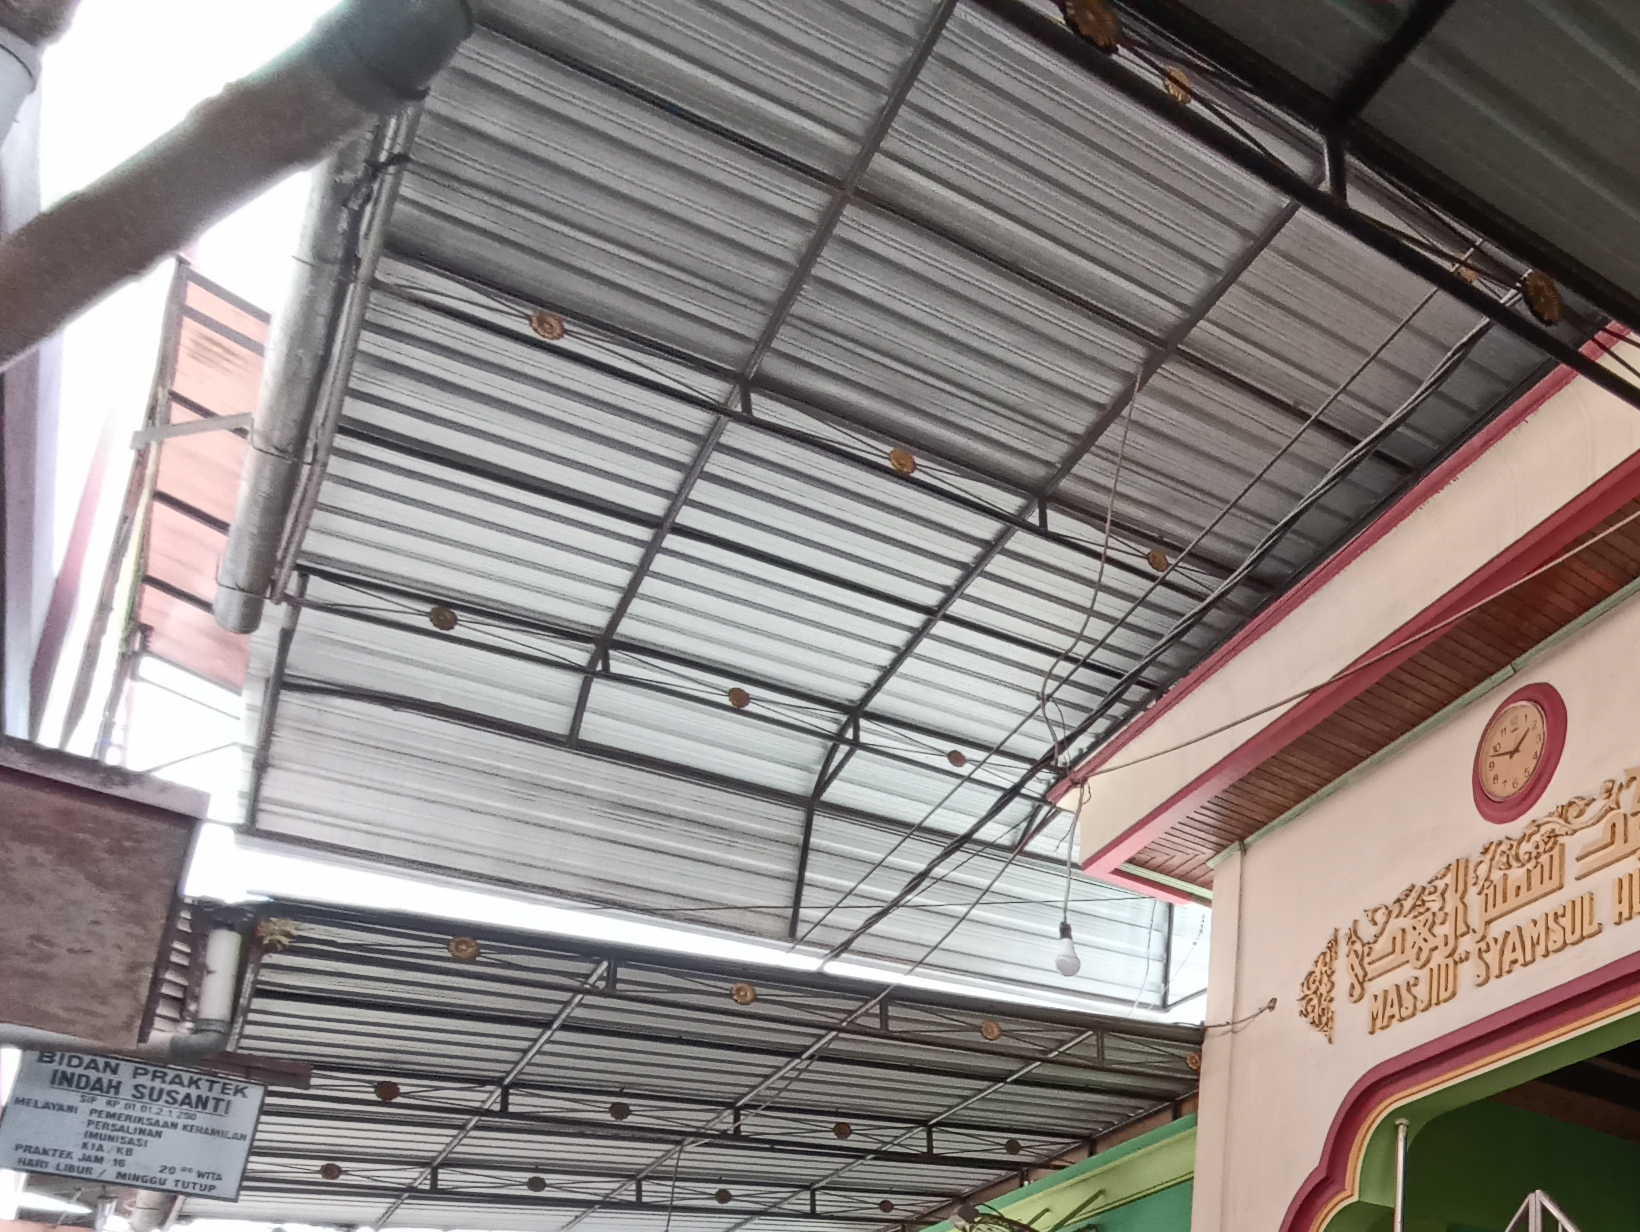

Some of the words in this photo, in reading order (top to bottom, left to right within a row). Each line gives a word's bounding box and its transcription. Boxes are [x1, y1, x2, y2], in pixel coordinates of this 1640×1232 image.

[1368, 957, 1459, 1035] MASJID
[37, 1050, 121, 1076] BIDAN
[132, 1066, 249, 1099] PRAKTEK
[50, 1068, 123, 1097] INDAH
[131, 1083, 233, 1115] SUSANTI
[14, 1096, 79, 1115] MELAYANI
[89, 1108, 179, 1130] PEMERIKSAAN
[86, 1118, 164, 1139] PERSALINAN
[83, 1130, 149, 1148] IMUNISASI
[14, 1143, 74, 1160] PRAKTEK
[78, 1153, 105, 1165] JAM
[113, 1158, 127, 1168] 16
[158, 1164, 177, 1175] 20
[17, 1156, 50, 1169] HARI
[55, 1162, 94, 1176] LIBUR
[115, 1170, 168, 1186] MINGGU
[173, 1178, 217, 1193] TUTUP
